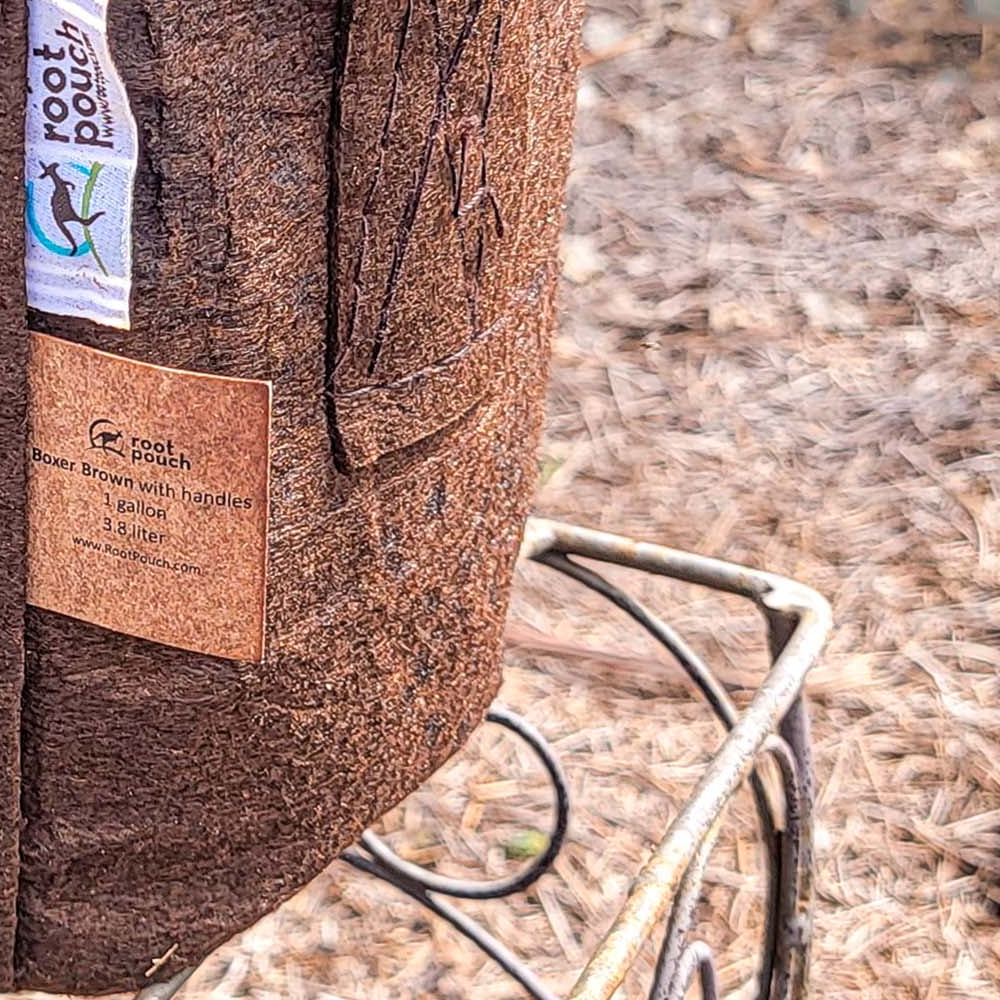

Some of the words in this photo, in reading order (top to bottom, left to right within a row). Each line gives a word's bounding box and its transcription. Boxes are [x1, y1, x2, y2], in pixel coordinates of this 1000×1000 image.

[33, 43, 70, 143] root
[55, 20, 114, 149] pouch
[131, 436, 174, 456] root
[131, 449, 191, 470] pouch
[32, 447, 76, 472] Boxer
[81, 462, 134, 489] Brown
[138, 481, 176, 499] with
[181, 486, 252, 509] handles
[103, 492, 112, 506] 1
[117, 499, 167, 520] gallon
[103, 517, 127, 535] 3.8
[132, 525, 166, 545] liter
[72, 535, 201, 575] www.RootPouch.com
